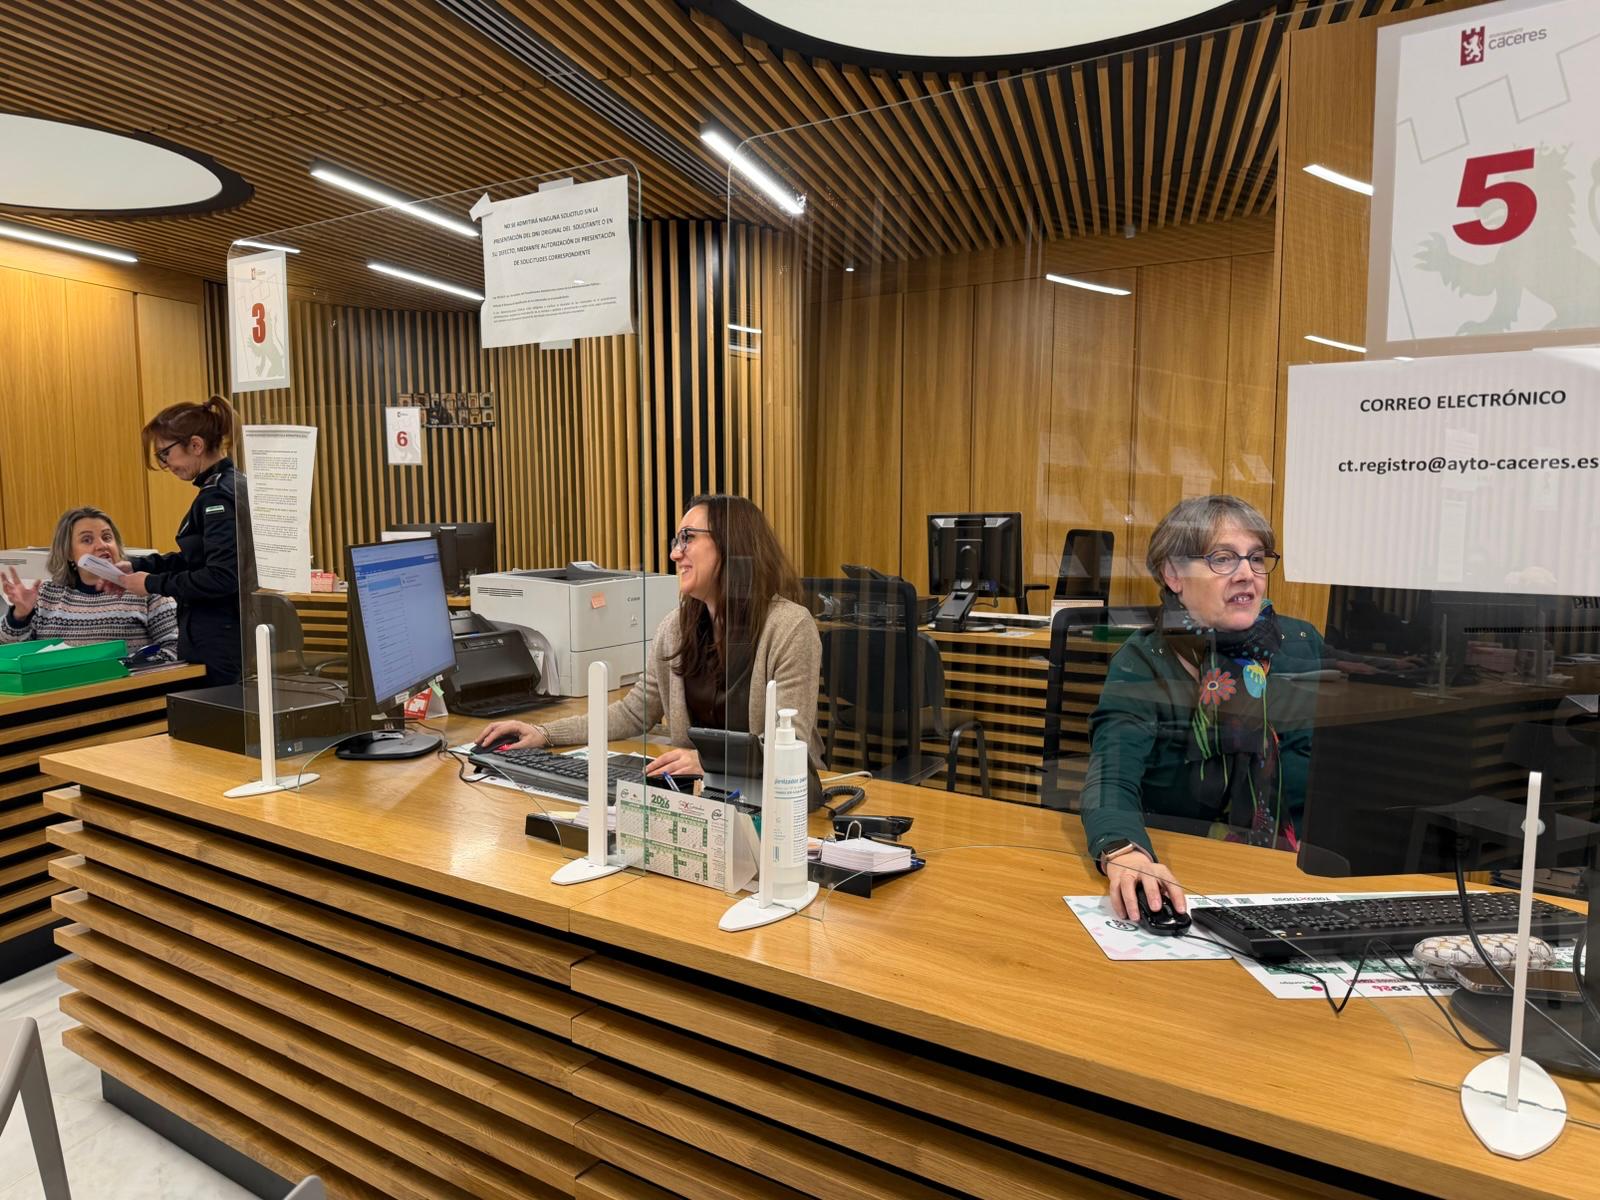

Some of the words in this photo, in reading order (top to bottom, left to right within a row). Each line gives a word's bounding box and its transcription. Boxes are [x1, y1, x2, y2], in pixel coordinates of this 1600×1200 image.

[1452, 148, 1538, 246] 5
[539, 213, 560, 223] NINGUNA
[561, 209, 584, 219] SOLICITUD
[541, 226, 562, 236] ORIGINAL
[520, 255, 548, 265] SOLICITUDES
[251, 303, 266, 344] 3
[1360, 396, 1431, 413] CORREO
[1437, 389, 1567, 409] ELECTRÓNICO
[396, 431, 408, 447] 6
[1338, 455, 1600, 475] ct.registro@ayto-caceres.es
[651, 793, 670, 809] 2026
